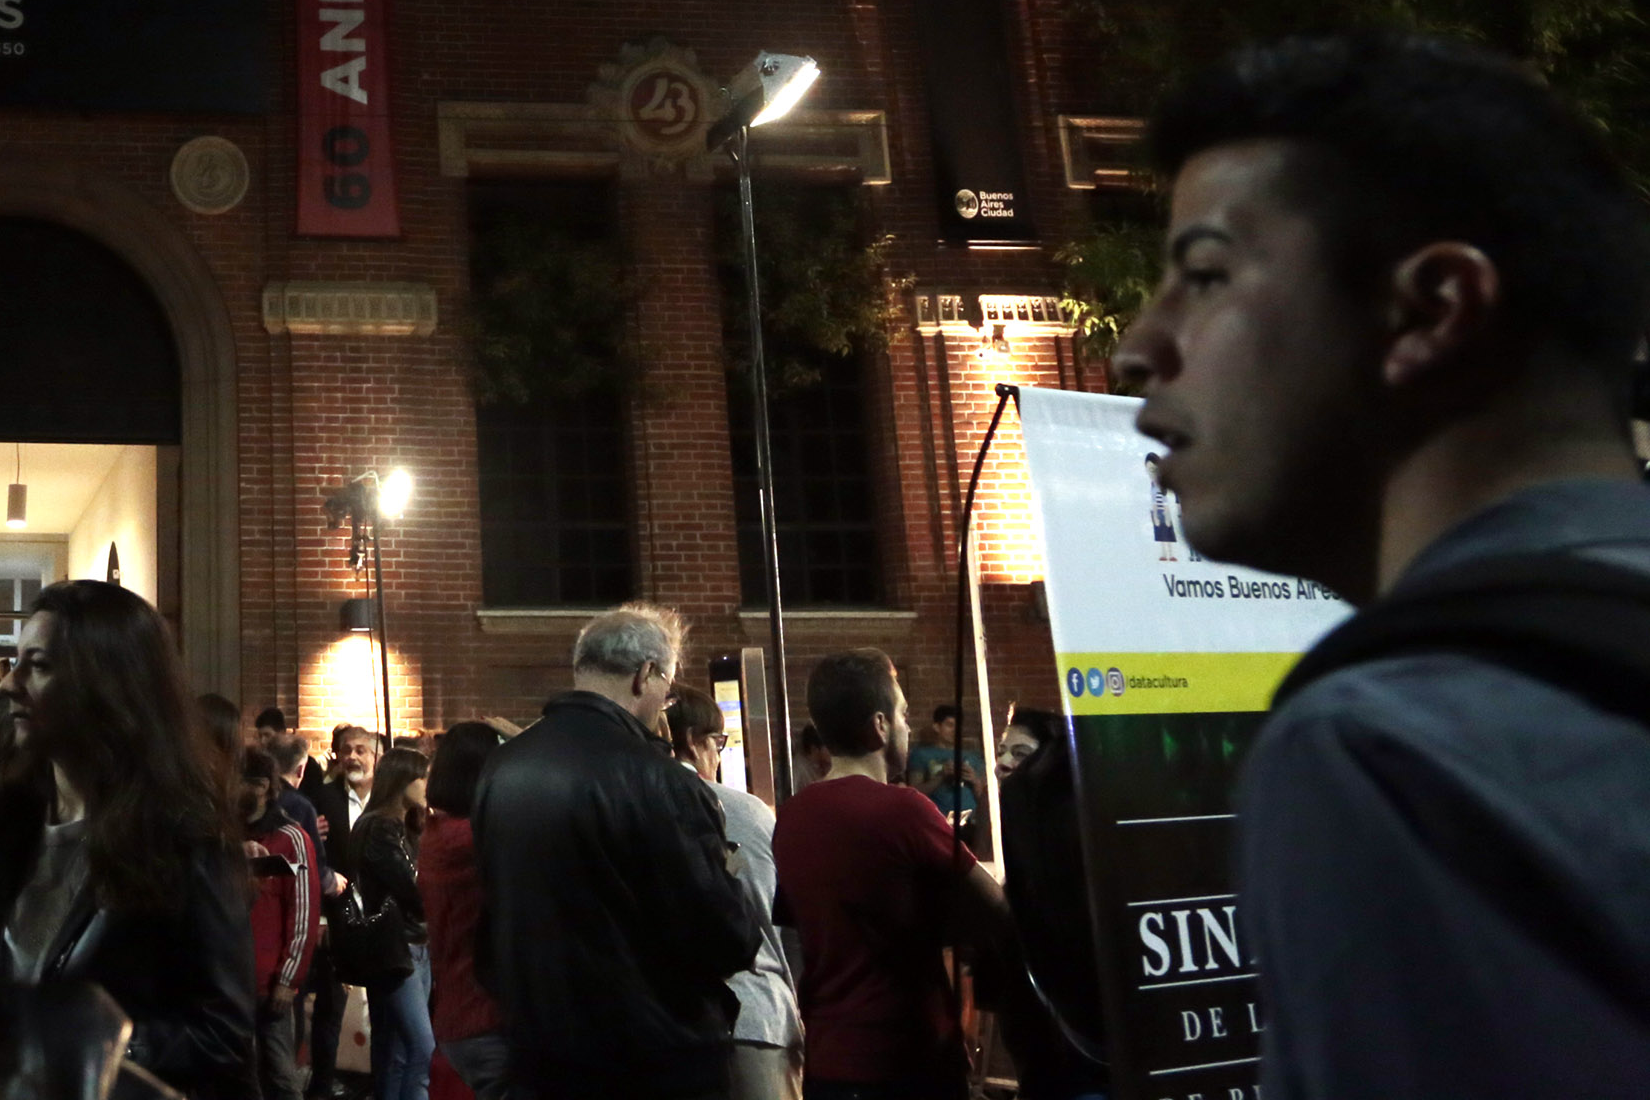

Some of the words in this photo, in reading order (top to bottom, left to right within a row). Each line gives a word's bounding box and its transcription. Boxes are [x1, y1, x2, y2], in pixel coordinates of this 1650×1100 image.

[323, 124, 372, 212] 60
[979, 190, 1014, 200] Buenos
[980, 200, 1005, 209] Aires
[980, 208, 1014, 218] Ciudad
[1163, 574, 1225, 599] Vamos
[1228, 575, 1291, 600] Buenos
[1138, 904, 1258, 978] SIN
[1180, 1006, 1228, 1042] DE
